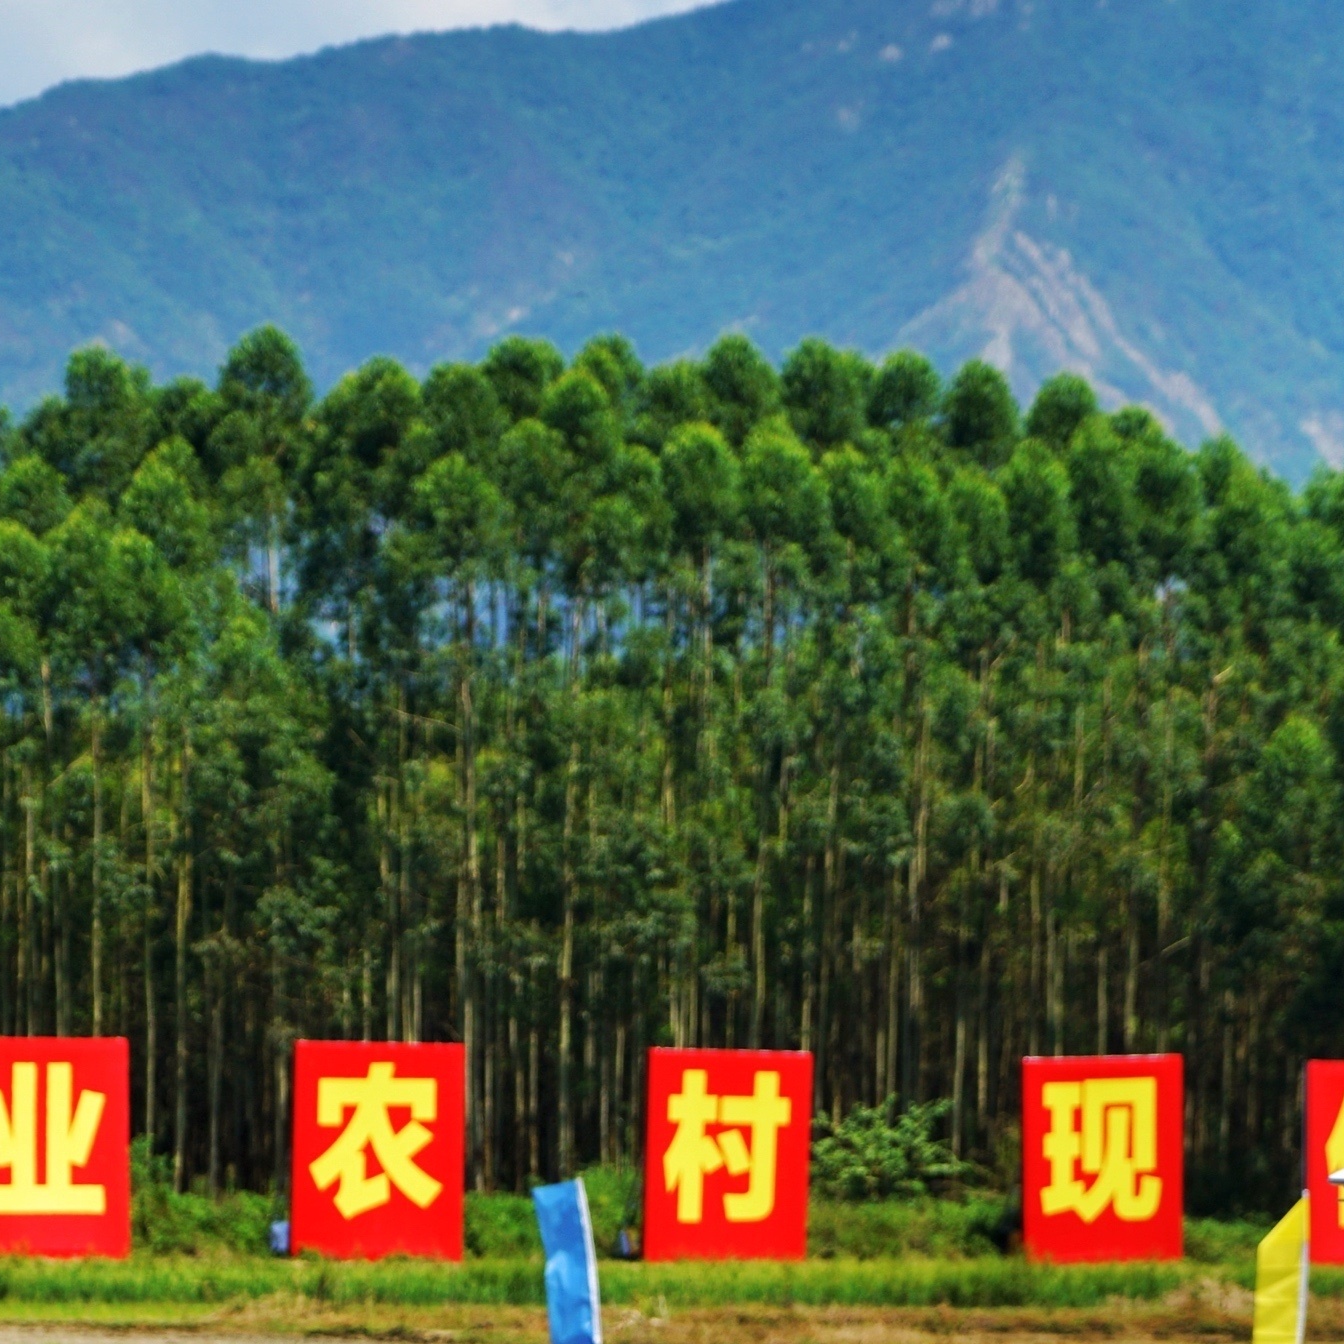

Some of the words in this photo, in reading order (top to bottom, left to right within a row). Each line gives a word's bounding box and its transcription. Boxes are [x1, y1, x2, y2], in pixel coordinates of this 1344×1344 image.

[309, 1062, 441, 1218] 农
[663, 1069, 791, 1223] 村
[1040, 1077, 1161, 1222] 现
